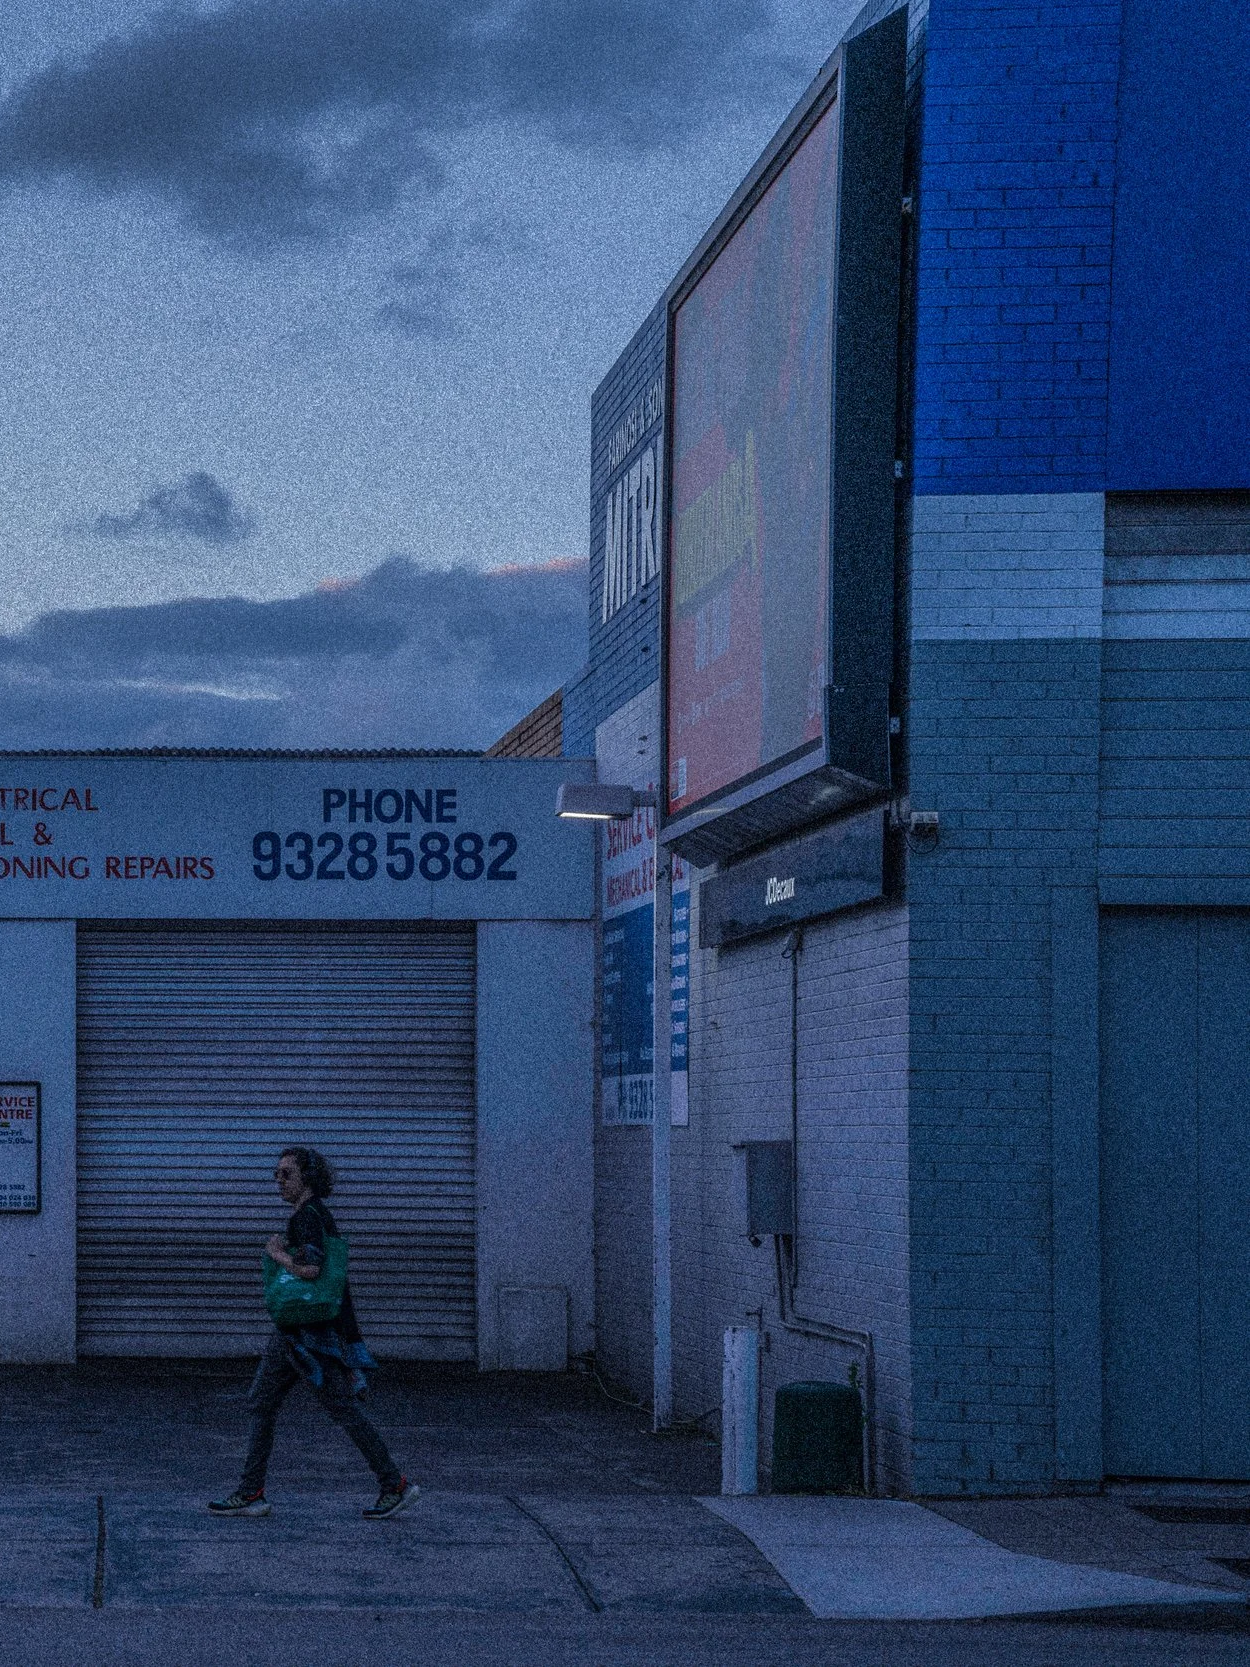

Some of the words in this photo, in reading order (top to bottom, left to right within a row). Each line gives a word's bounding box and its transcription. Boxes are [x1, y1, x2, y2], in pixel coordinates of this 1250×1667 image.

[322, 788, 457, 823] PHONE
[33, 821, 53, 846] &
[105, 855, 215, 880] REPAIRS
[252, 831, 517, 881] 93285882
[765, 876, 795, 905] JCDecaux
